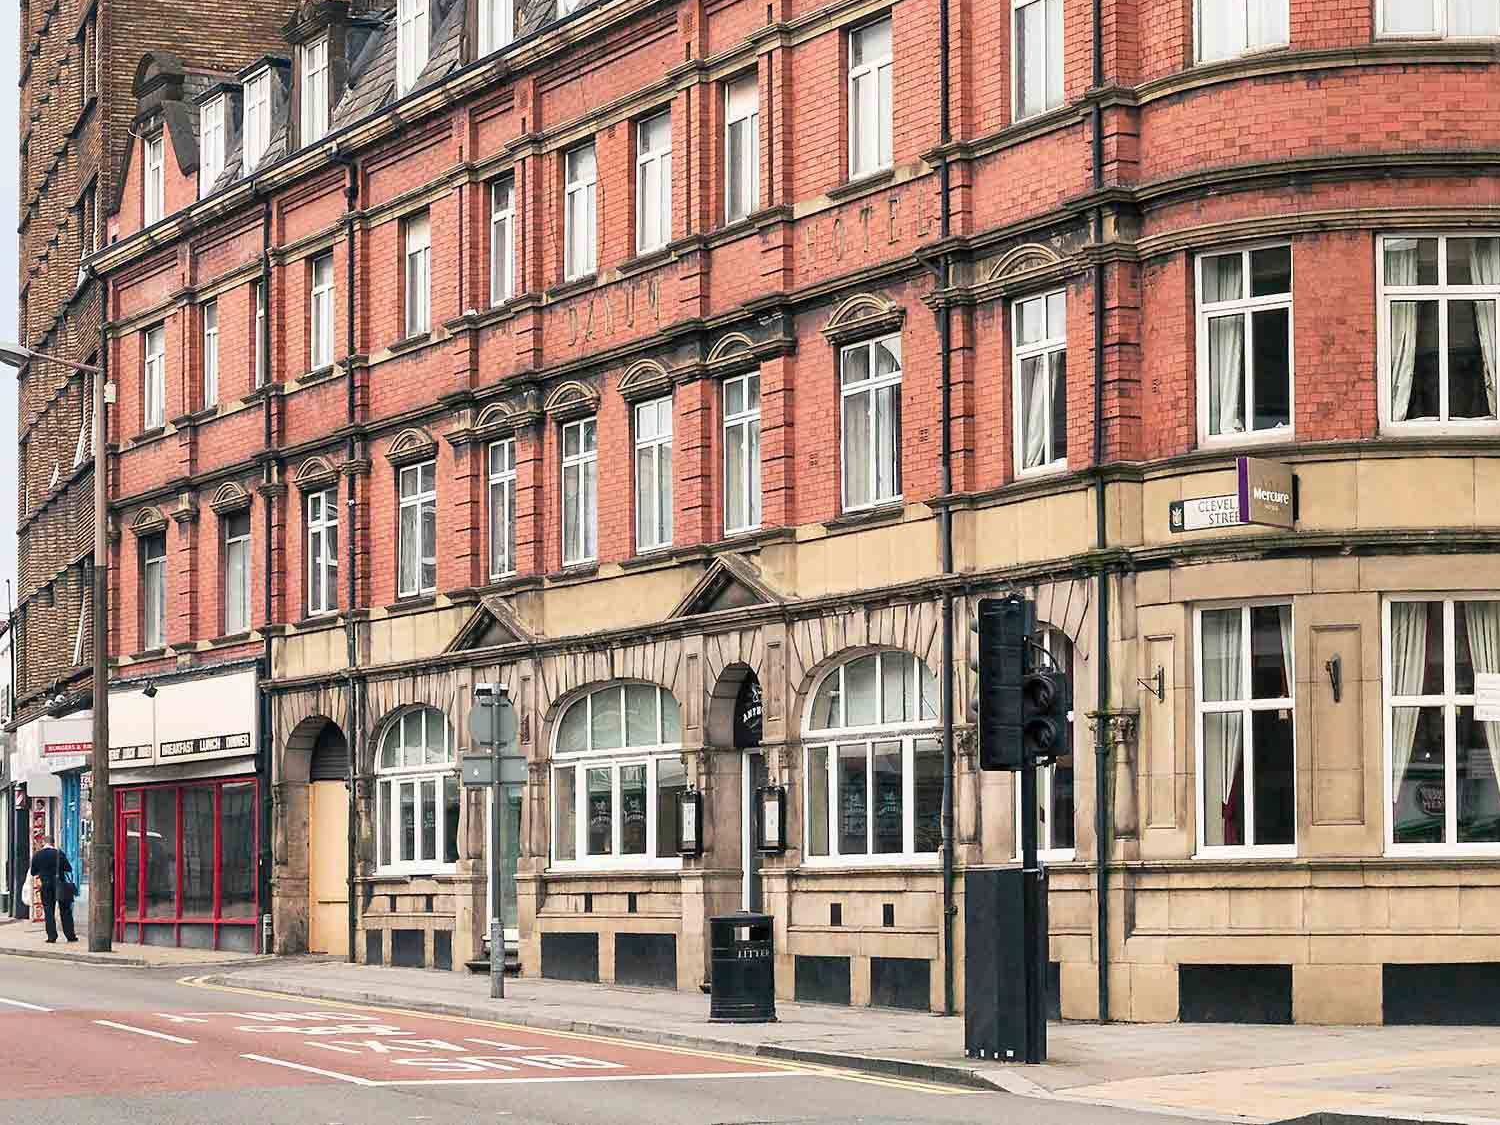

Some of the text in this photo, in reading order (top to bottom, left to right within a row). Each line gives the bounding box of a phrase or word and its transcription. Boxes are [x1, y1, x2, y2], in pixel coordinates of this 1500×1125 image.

[1253, 486, 1289, 504] Mercure
[1209, 511, 1240, 524] STREE
[302, 1037, 552, 1054] TAXI
[388, 1055, 630, 1072] BUS
